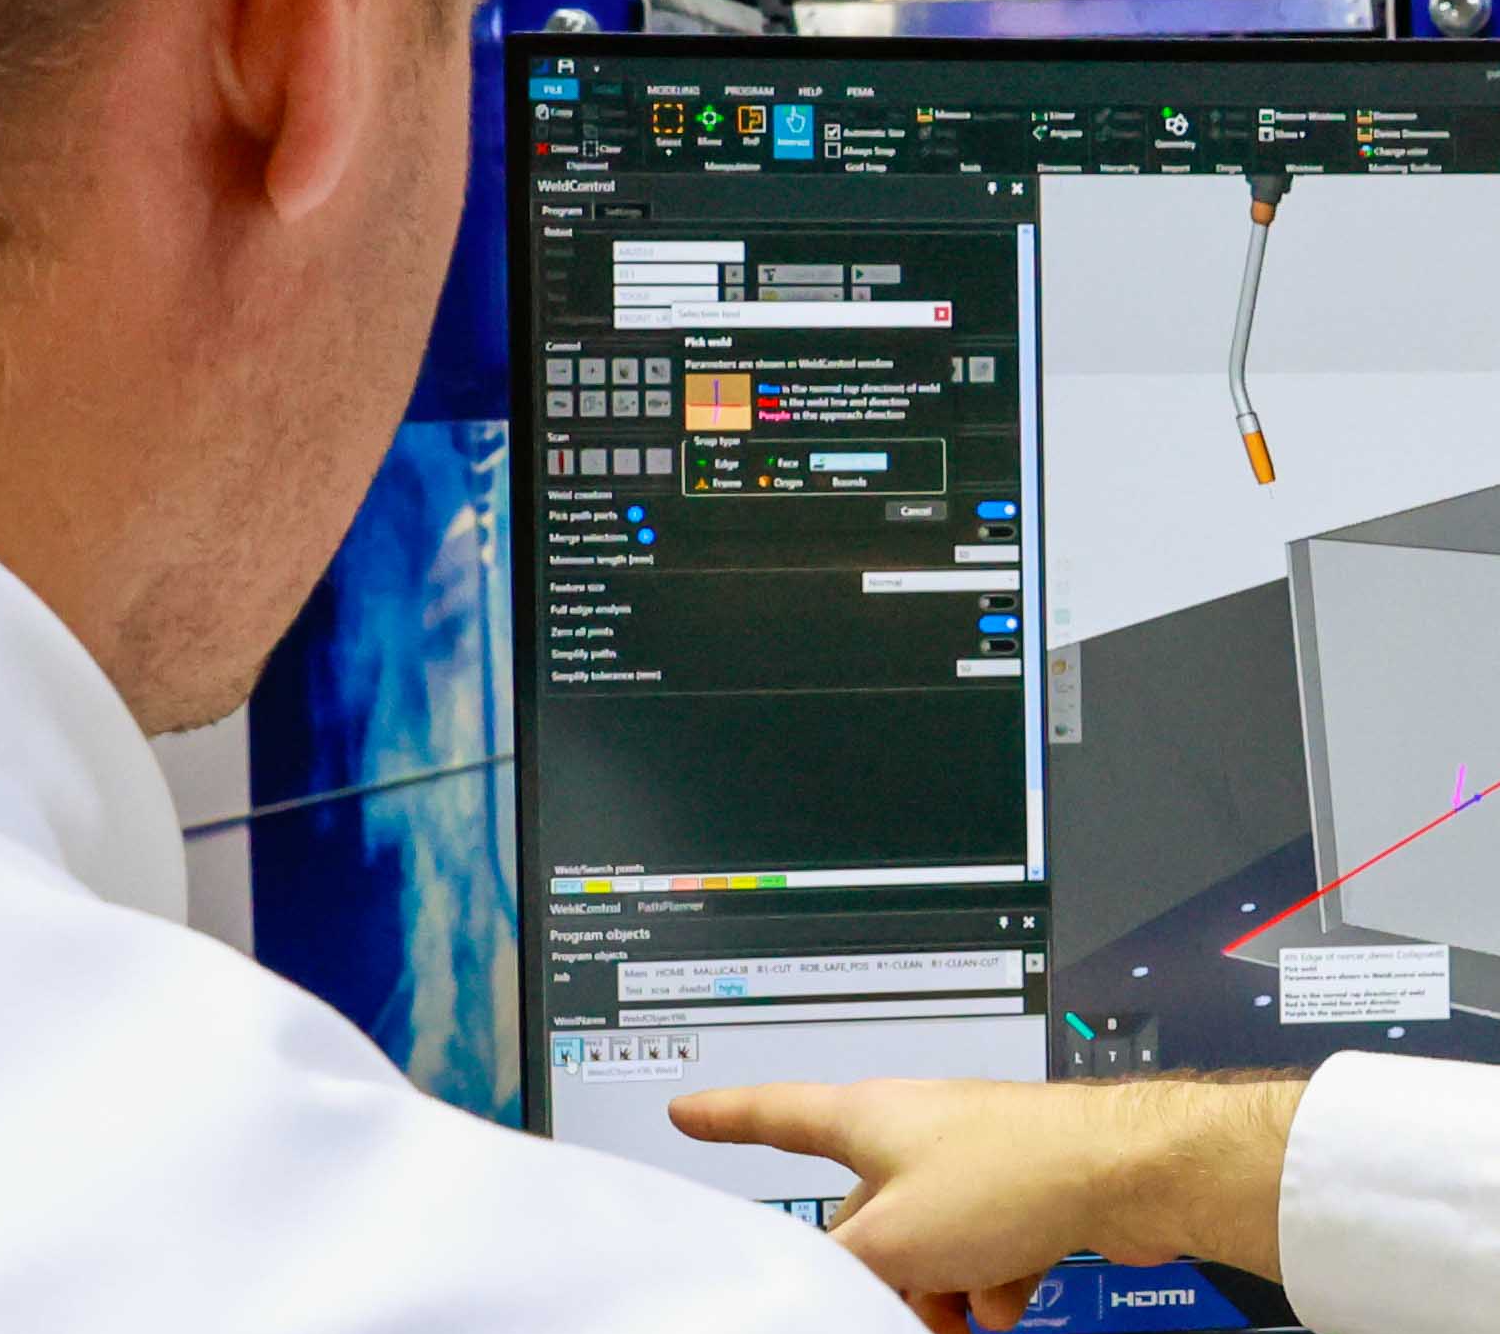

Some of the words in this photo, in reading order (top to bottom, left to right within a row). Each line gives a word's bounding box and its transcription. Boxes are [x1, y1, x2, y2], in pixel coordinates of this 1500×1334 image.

[647, 86, 700, 96] MODELING
[725, 86, 774, 96] PROGRAM
[799, 87, 823, 97] HELP
[847, 87, 874, 97] PEMA
[537, 180, 615, 193] WeldControl
[542, 205, 582, 217] Program
[685, 337, 705, 347] Pick
[708, 337, 732, 347] weld
[791, 383, 807, 394] the
[789, 397, 805, 407] the
[802, 410, 818, 420] the
[820, 410, 863, 422] approach
[547, 432, 569, 442] Scan
[694, 436, 717, 447] Snap
[720, 437, 740, 447] type
[715, 459, 739, 470] Edge
[548, 490, 572, 500] Weld
[900, 506, 932, 516] Cancel
[550, 582, 585, 592] Feature
[869, 578, 903, 587] Normal
[550, 605, 567, 615] Full
[569, 605, 593, 616] edge
[554, 864, 614, 875] Weld/Search
[550, 902, 621, 915] WeldControl
[550, 929, 604, 944] Program
[606, 928, 651, 943] objects
[552, 952, 593, 962] Program
[594, 951, 628, 961] objects
[656, 969, 685, 978] HOME
[877, 960, 923, 970] R1-CLEAN
[1110, 1289, 1195, 1308] HDMI
